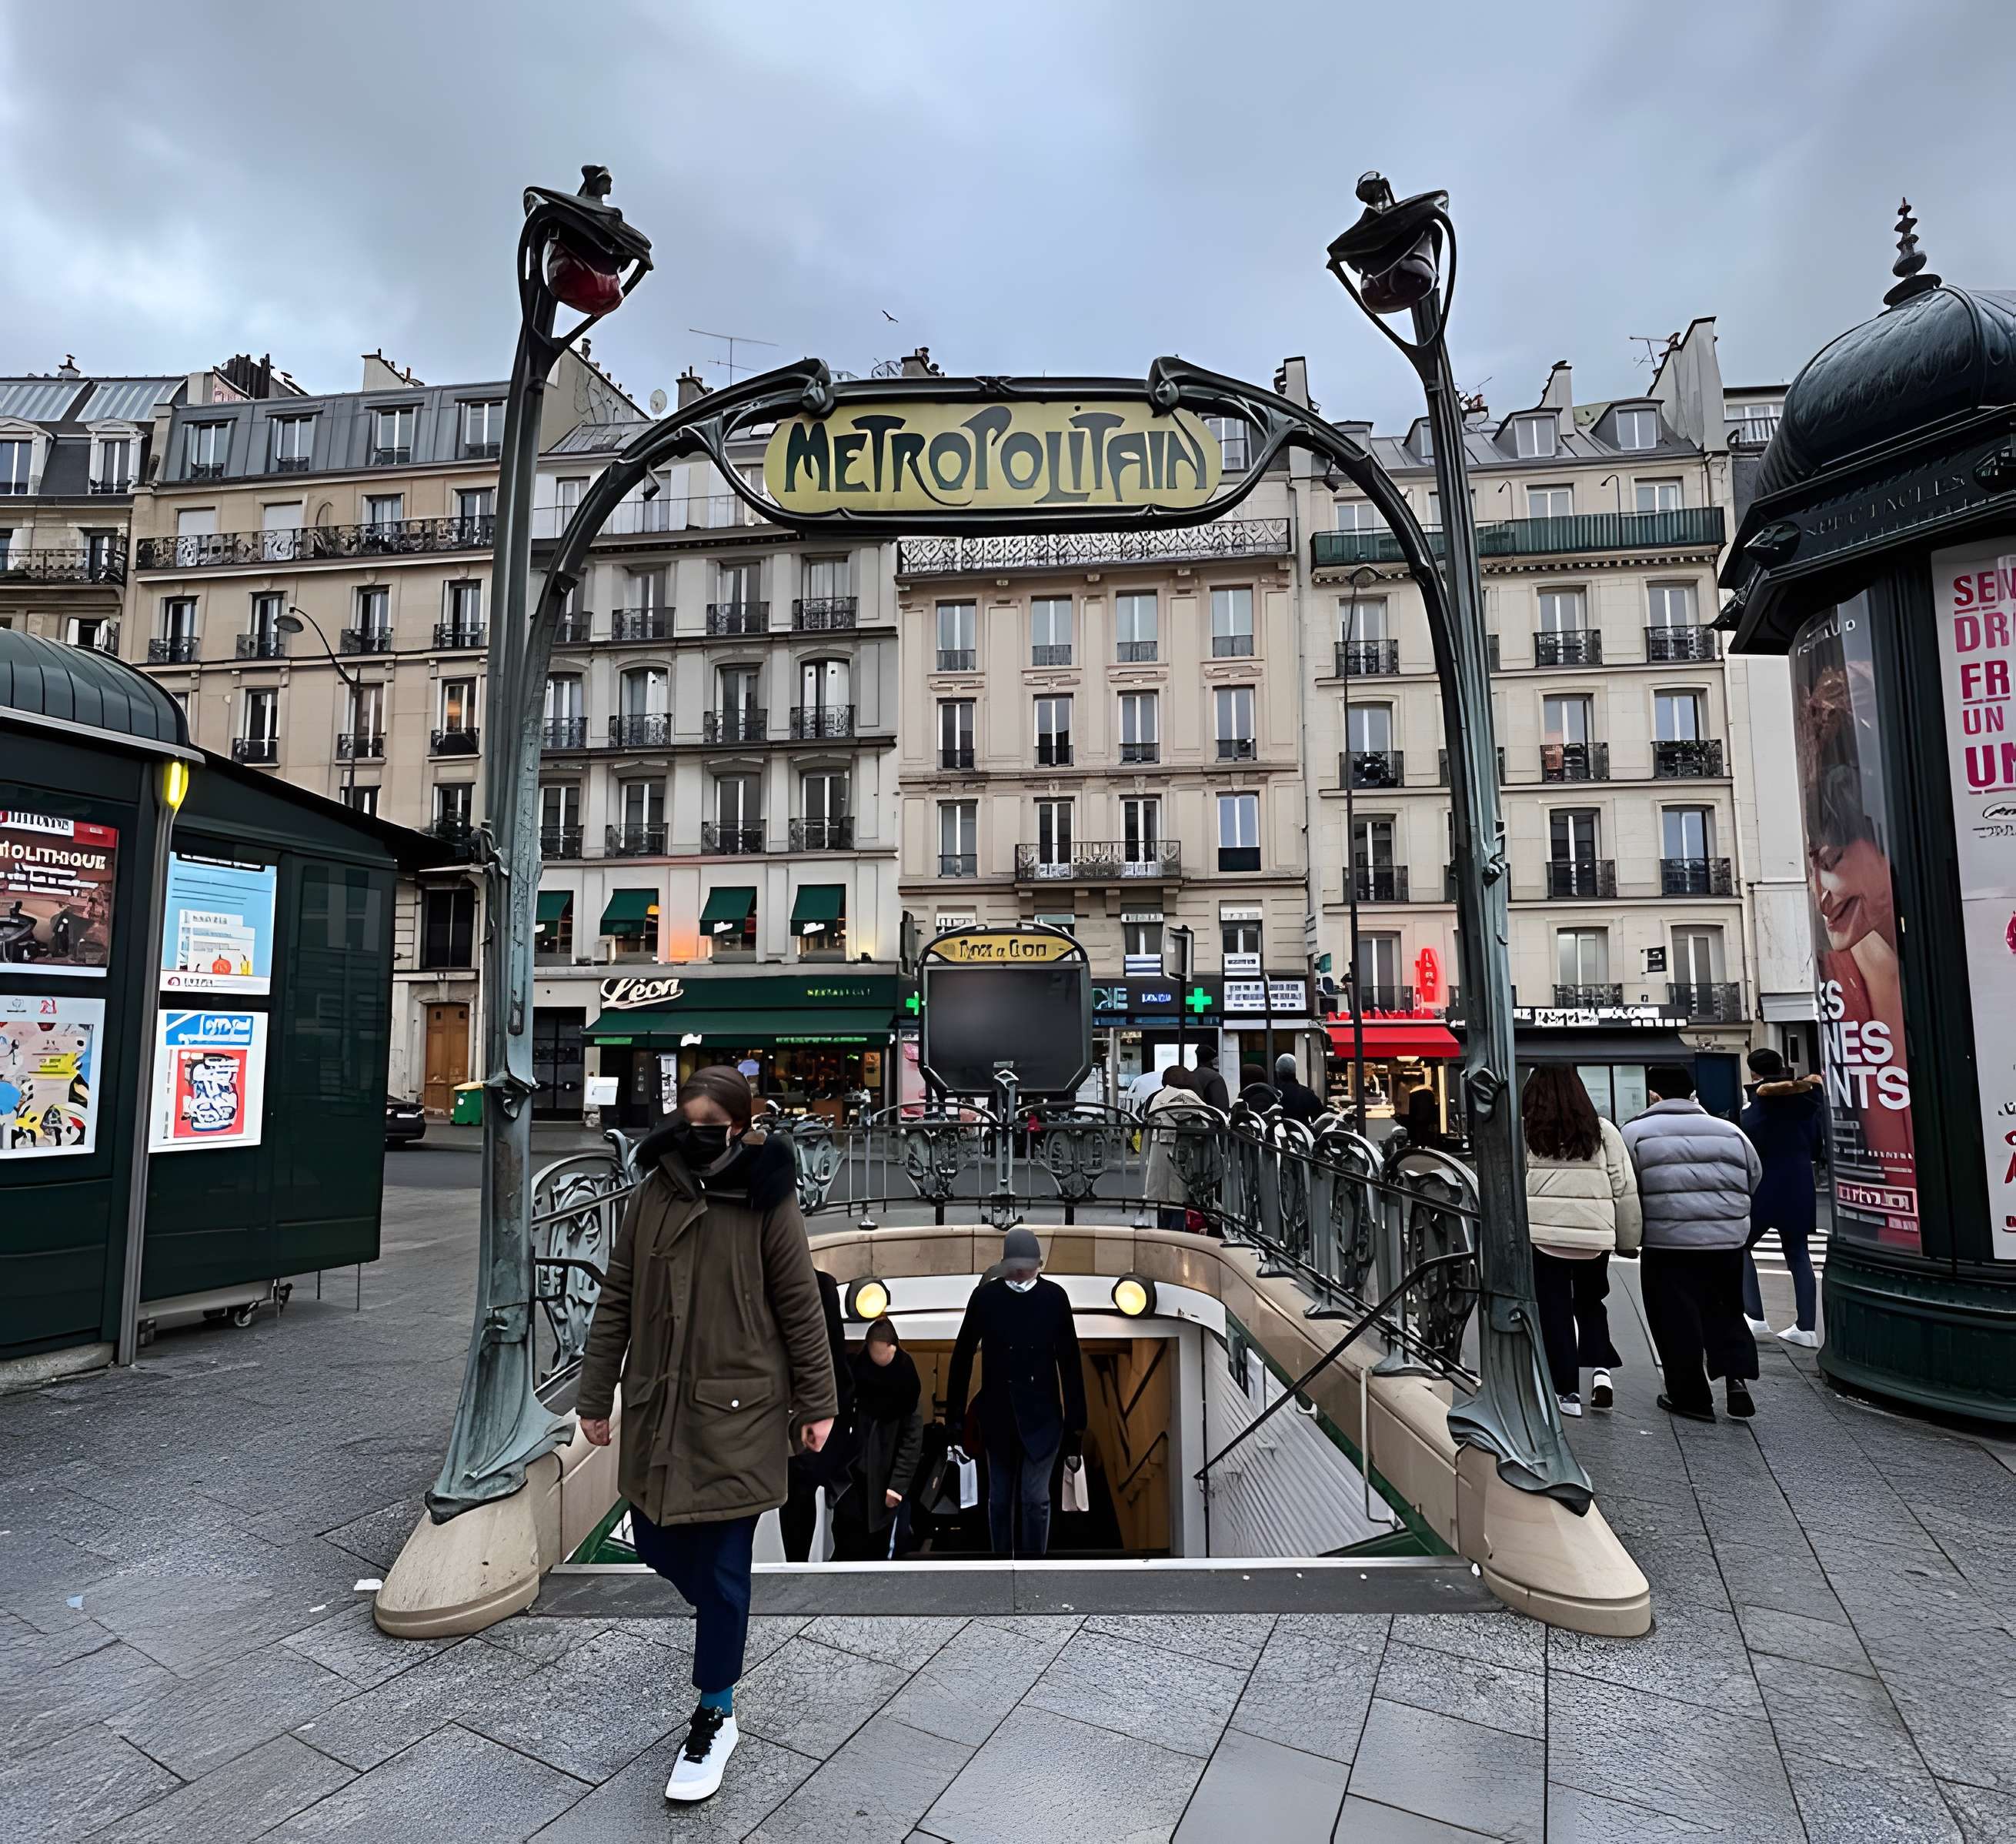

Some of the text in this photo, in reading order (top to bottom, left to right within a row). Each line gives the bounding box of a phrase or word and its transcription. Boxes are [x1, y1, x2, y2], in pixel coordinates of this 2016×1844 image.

[784, 405, 1208, 506] METROPOLITAIN
[1954, 611, 2016, 653] DR
[1963, 706, 2004, 736] UN
[600, 977, 684, 1009] Léon
